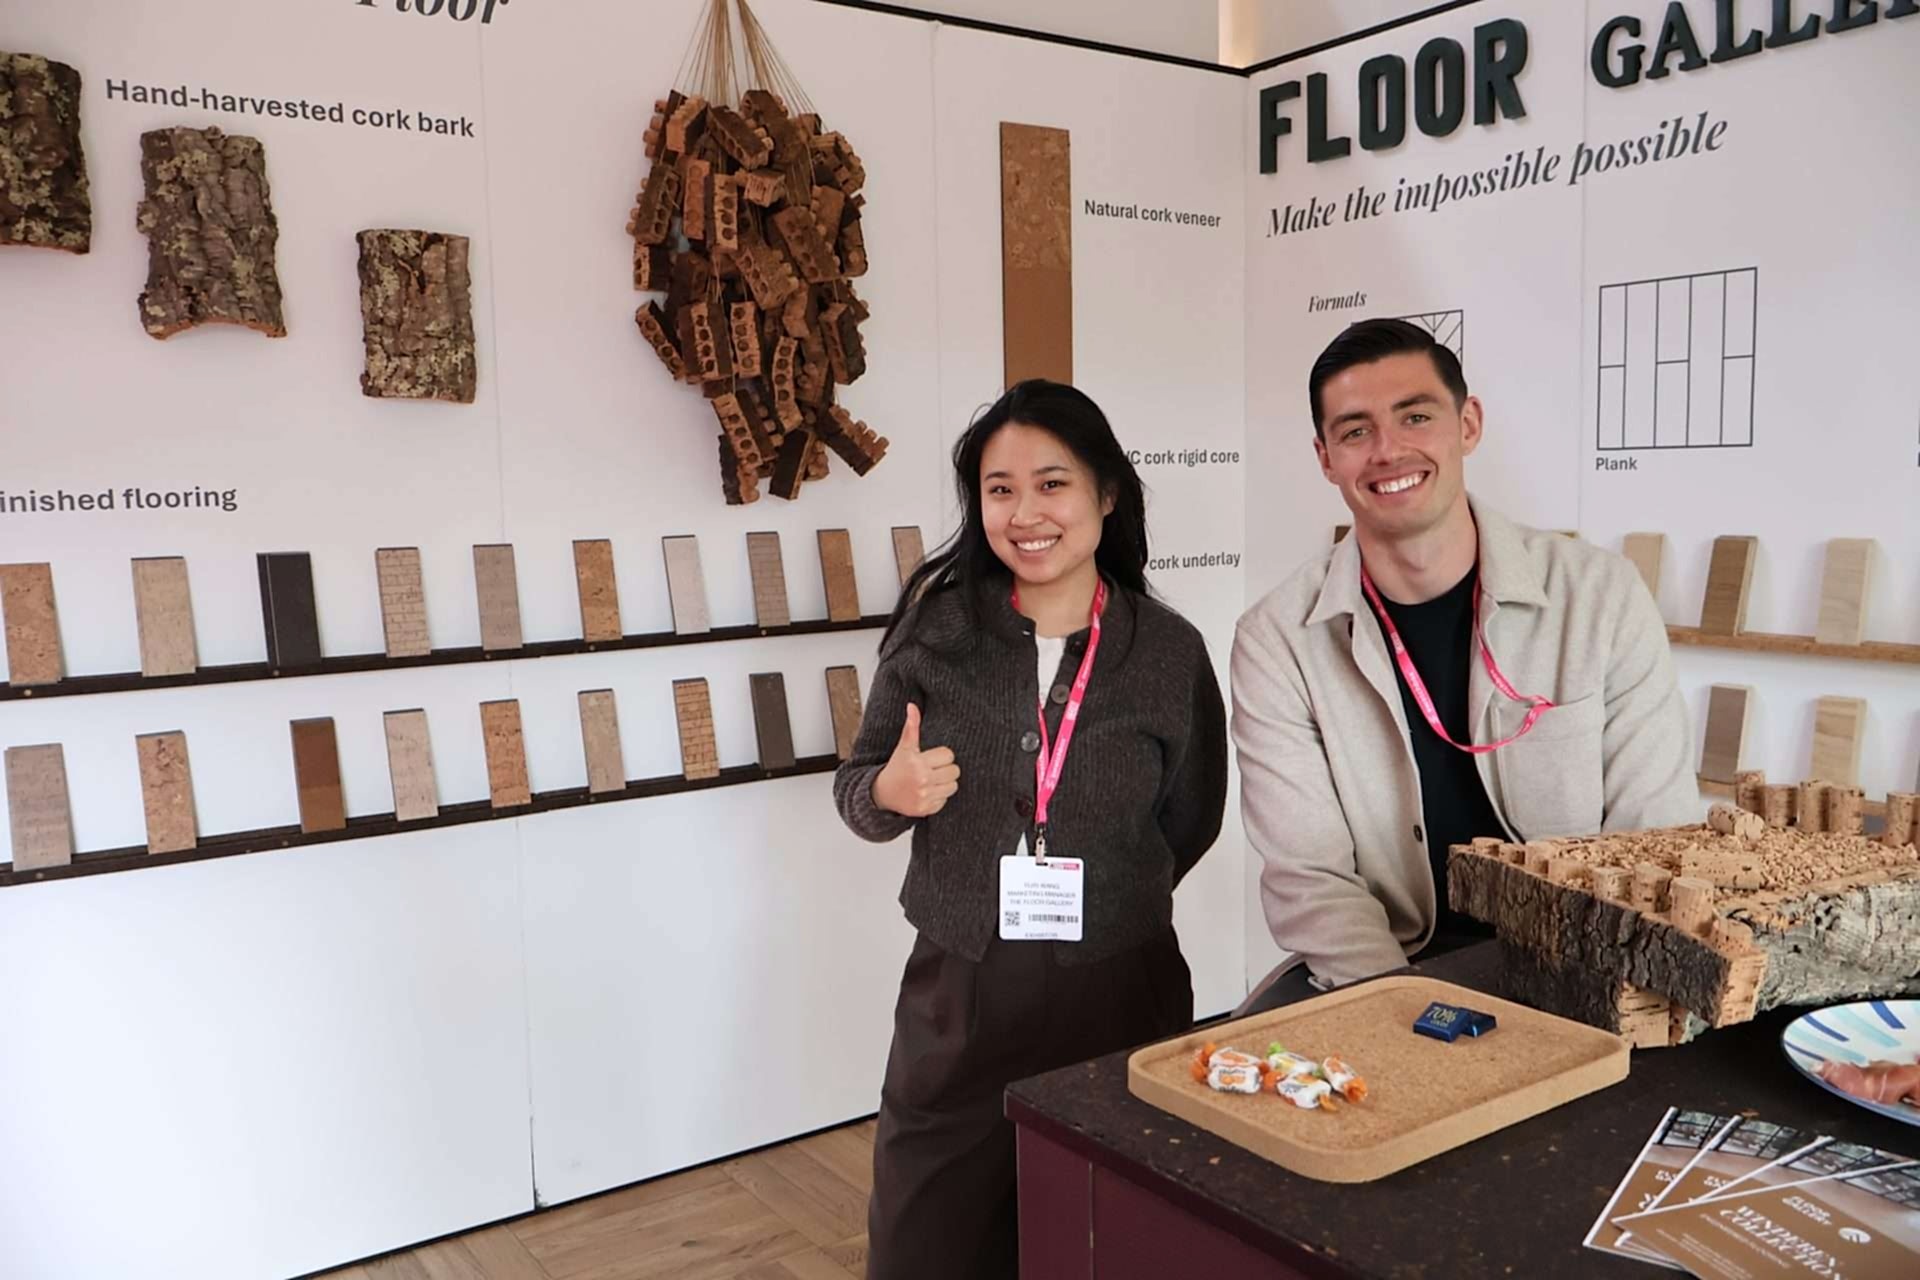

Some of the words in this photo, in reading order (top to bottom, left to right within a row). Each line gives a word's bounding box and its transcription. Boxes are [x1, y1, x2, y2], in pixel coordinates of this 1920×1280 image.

[355, 0, 510, 25] oor
[1259, 18, 1529, 175] FLOOR
[1590, 0, 1920, 88] GALL
[105, 78, 345, 124] Hand-harvested
[351, 108, 412, 131] cork
[417, 111, 475, 139] bark
[1266, 197, 1337, 238] Make
[1343, 186, 1387, 222] the
[1394, 146, 1561, 213] impossible
[1567, 112, 1729, 186] possible
[1084, 199, 1139, 220] Natural
[1141, 208, 1173, 223] cork
[1174, 211, 1222, 228] veneer
[1308, 291, 1368, 313] Formats
[1144, 449, 1175, 465] cork
[1178, 448, 1208, 468] rigid
[1210, 451, 1240, 464] core
[1595, 456, 1638, 471] Plank
[121, 485, 238, 512] flooring
[1149, 554, 1180, 571] cork
[1182, 551, 1241, 569] underlay
